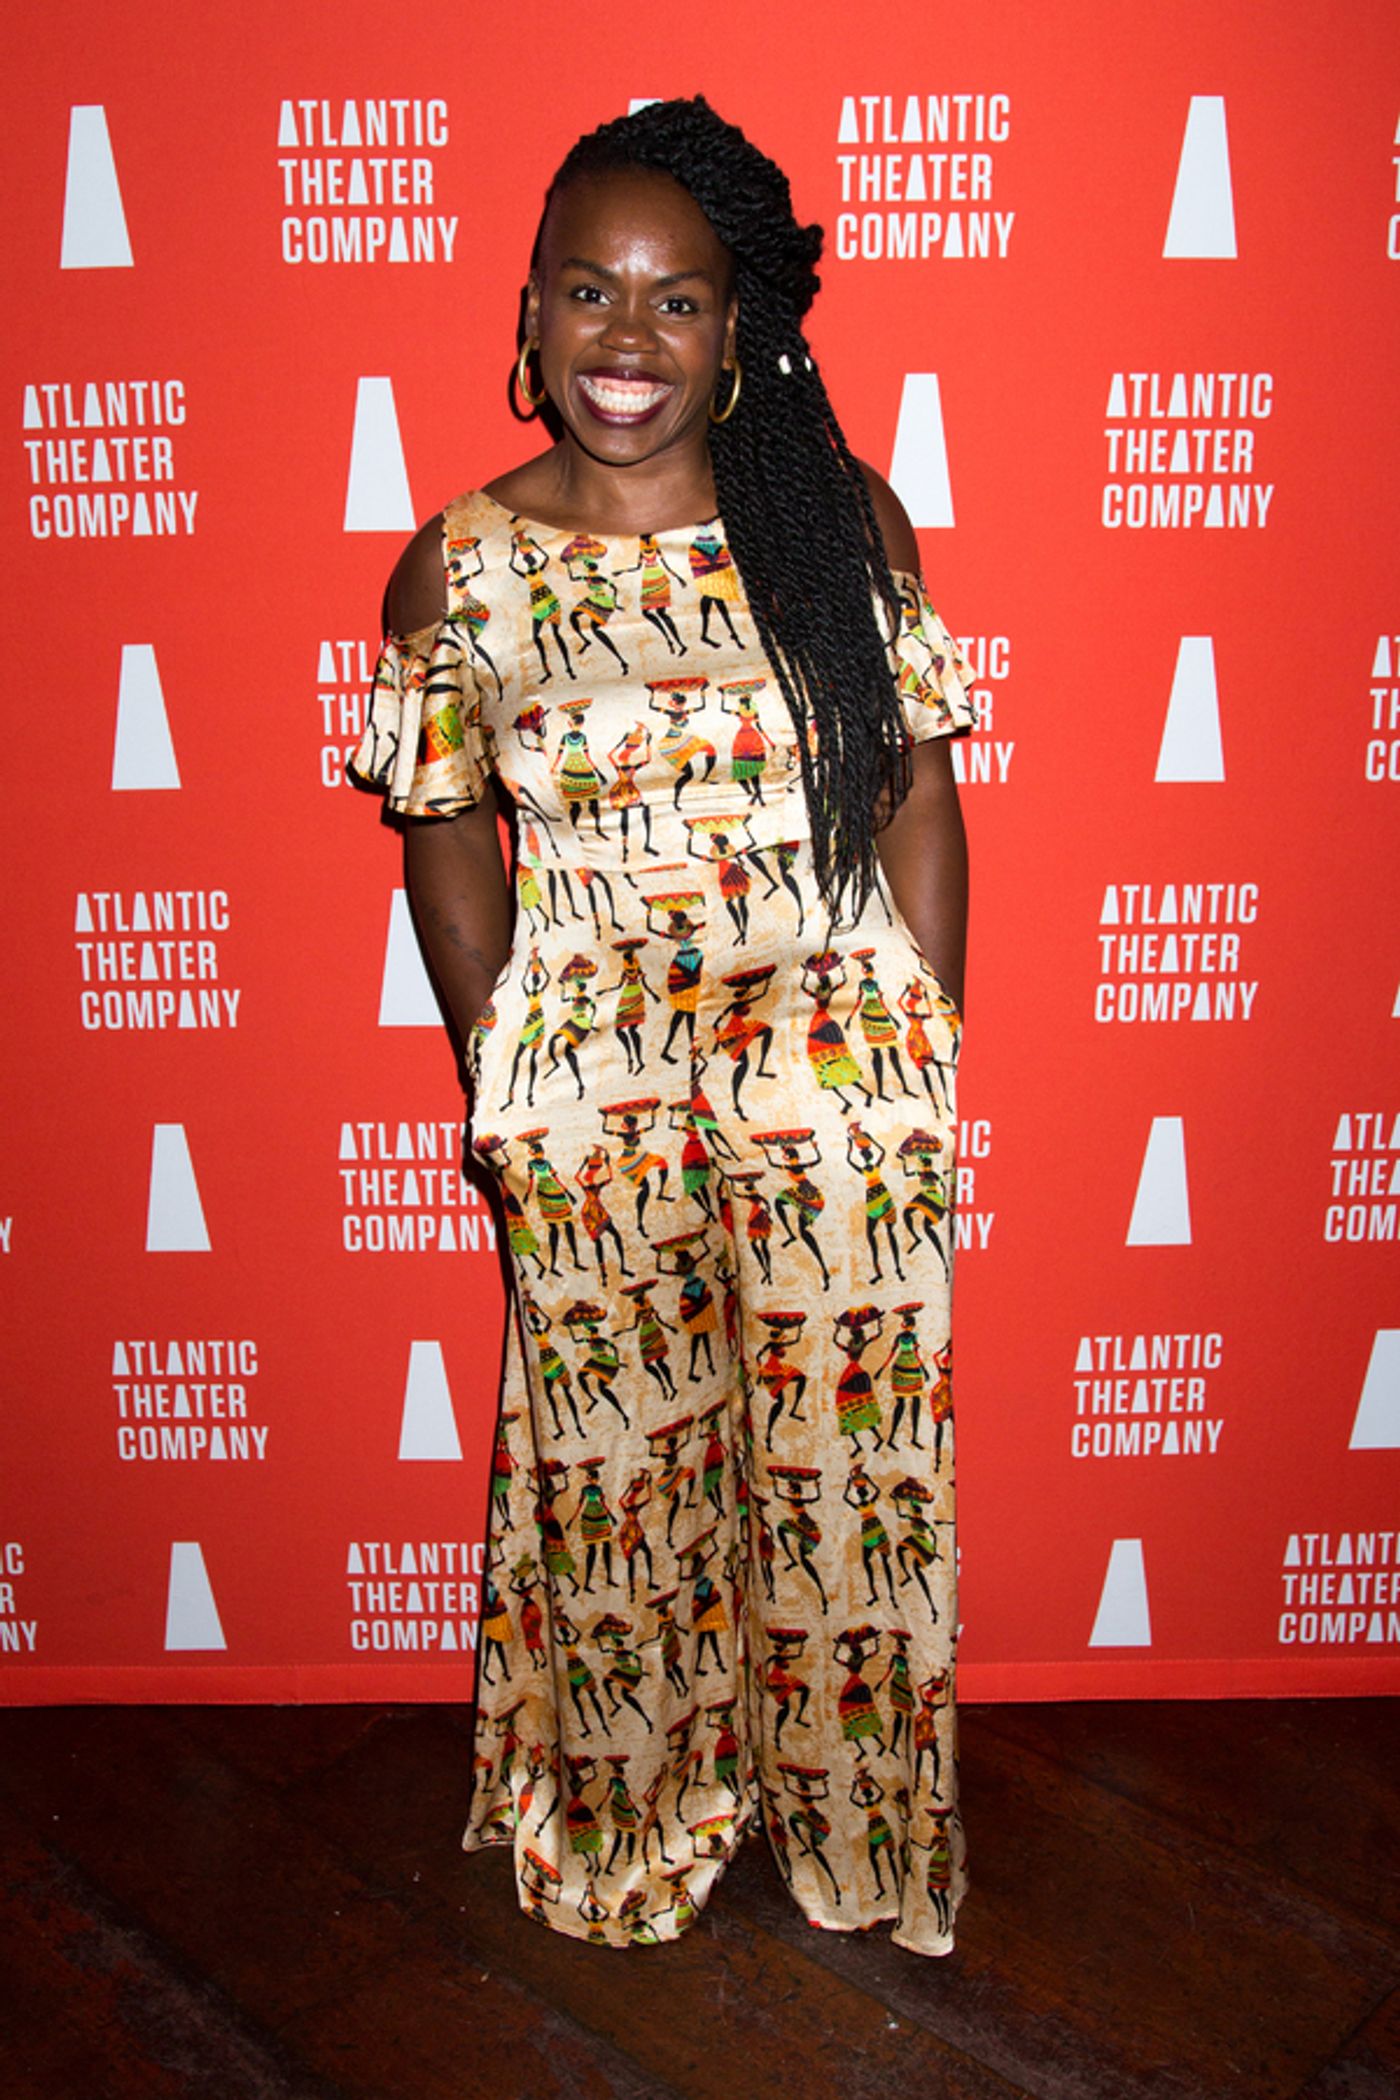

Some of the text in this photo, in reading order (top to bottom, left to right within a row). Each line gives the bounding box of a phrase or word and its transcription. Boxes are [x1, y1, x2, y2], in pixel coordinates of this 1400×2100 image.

[278, 99, 448, 147] ATLANTIC
[837, 94, 1010, 144] ATLANTIC
[278, 158, 433, 205] THEATER
[836, 153, 992, 202] THEATER
[282, 216, 458, 263] COMPANY
[836, 211, 1015, 260] COMPANY
[23, 380, 186, 429] ATLANTIC
[1106, 373, 1273, 418] ATLANTIC
[24, 437, 174, 483] THEATER
[1104, 429, 1254, 473] THEATER
[30, 491, 198, 539] COMPANY
[1102, 483, 1274, 528] COMPANY
[75, 890, 229, 932] ATLANTIC
[1099, 883, 1258, 925] ATLANTIC
[76, 941, 217, 981] THEATER
[1098, 933, 1240, 974] THEATER
[81, 989, 240, 1029] COMPANY
[1095, 982, 1258, 1023] COMPANY
[339, 1122, 465, 1160] ATLANT
[1333, 1113, 1400, 1150] ATLA
[1331, 1159, 1400, 1196] THEA
[113, 1341, 257, 1375] ATLANTIC
[1075, 1333, 1222, 1372] ATLANTIC
[113, 1384, 246, 1418] THEATER
[1074, 1378, 1205, 1415] THEATER
[118, 1427, 268, 1460] COMPANY
[1072, 1420, 1223, 1457] COMPANY
[1284, 1533, 1400, 1566] ATLANT
[348, 1582, 477, 1613] THEATER
[351, 1620, 477, 1650] COMPAN
[1279, 1612, 1400, 1643] COMPAN
